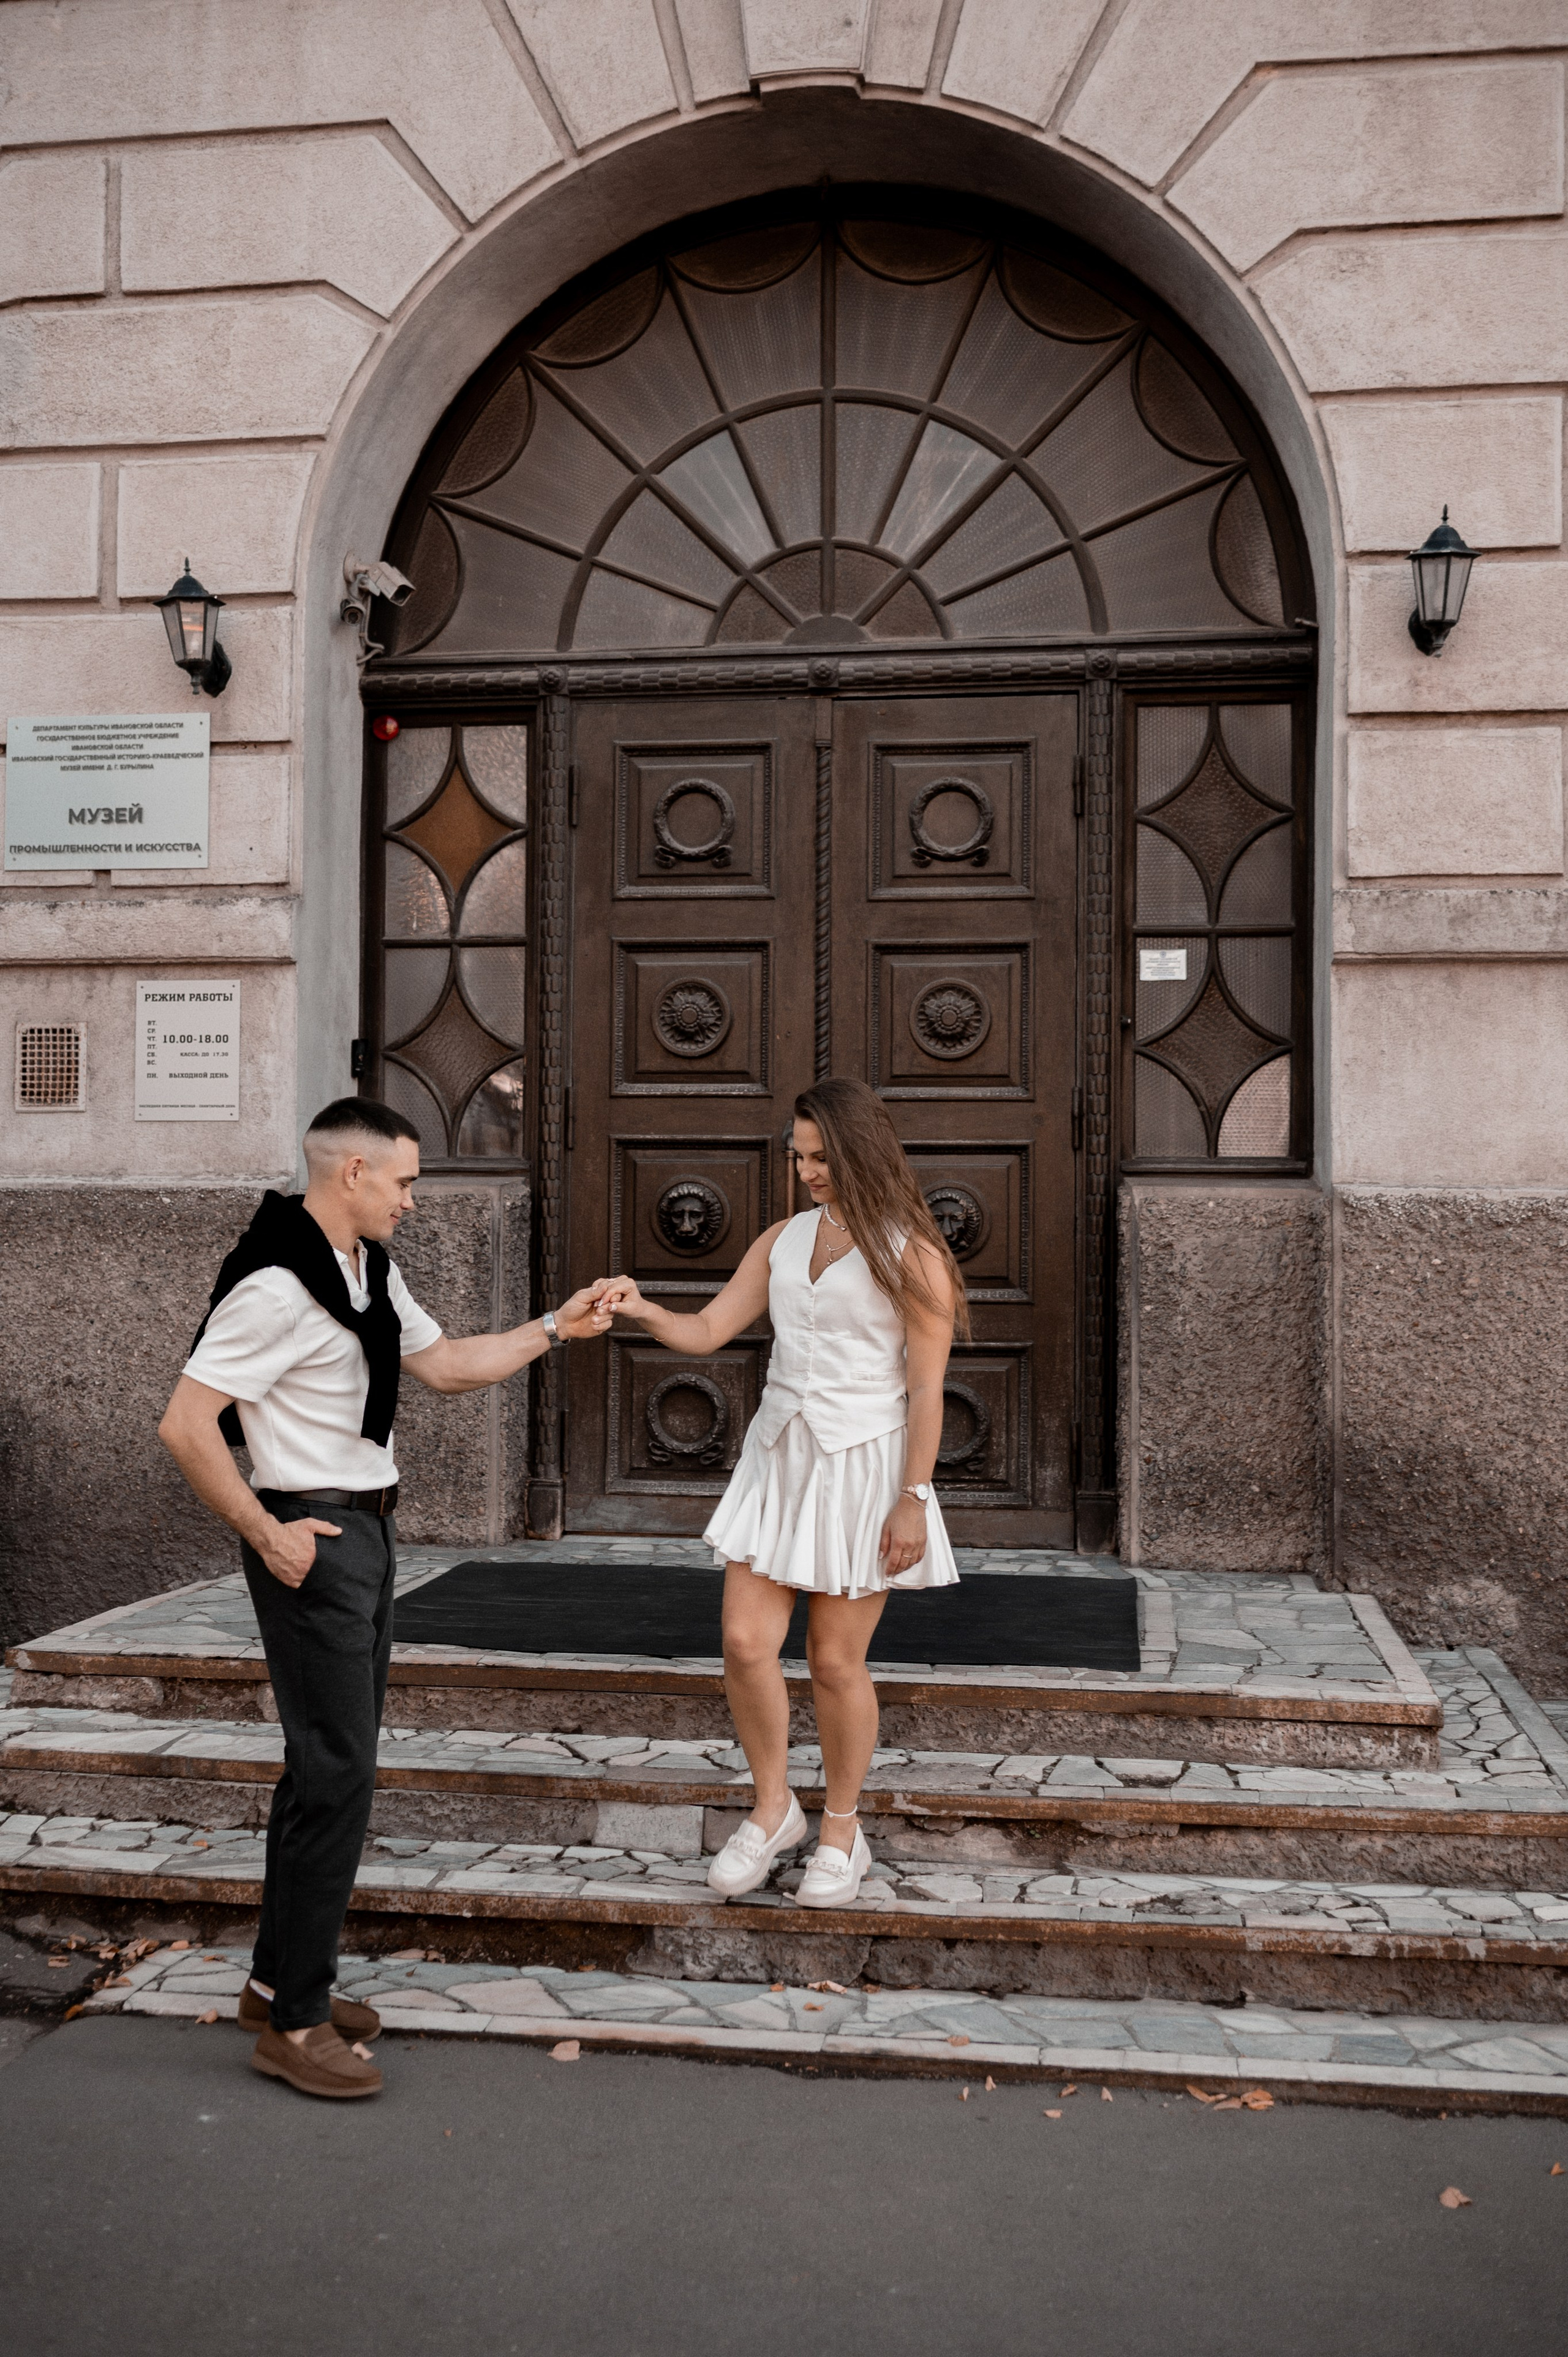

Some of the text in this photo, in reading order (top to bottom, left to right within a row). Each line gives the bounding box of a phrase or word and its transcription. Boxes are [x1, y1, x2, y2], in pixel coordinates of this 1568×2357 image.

[68, 803, 143, 825] МУЗЕЙ
[9, 842, 202, 853] ПРОМЫШЛЕННОСТИ И ИСКУССТВА
[189, 993, 233, 1002] РАБОТЫ
[163, 1034, 229, 1043] 10.00-18.00
